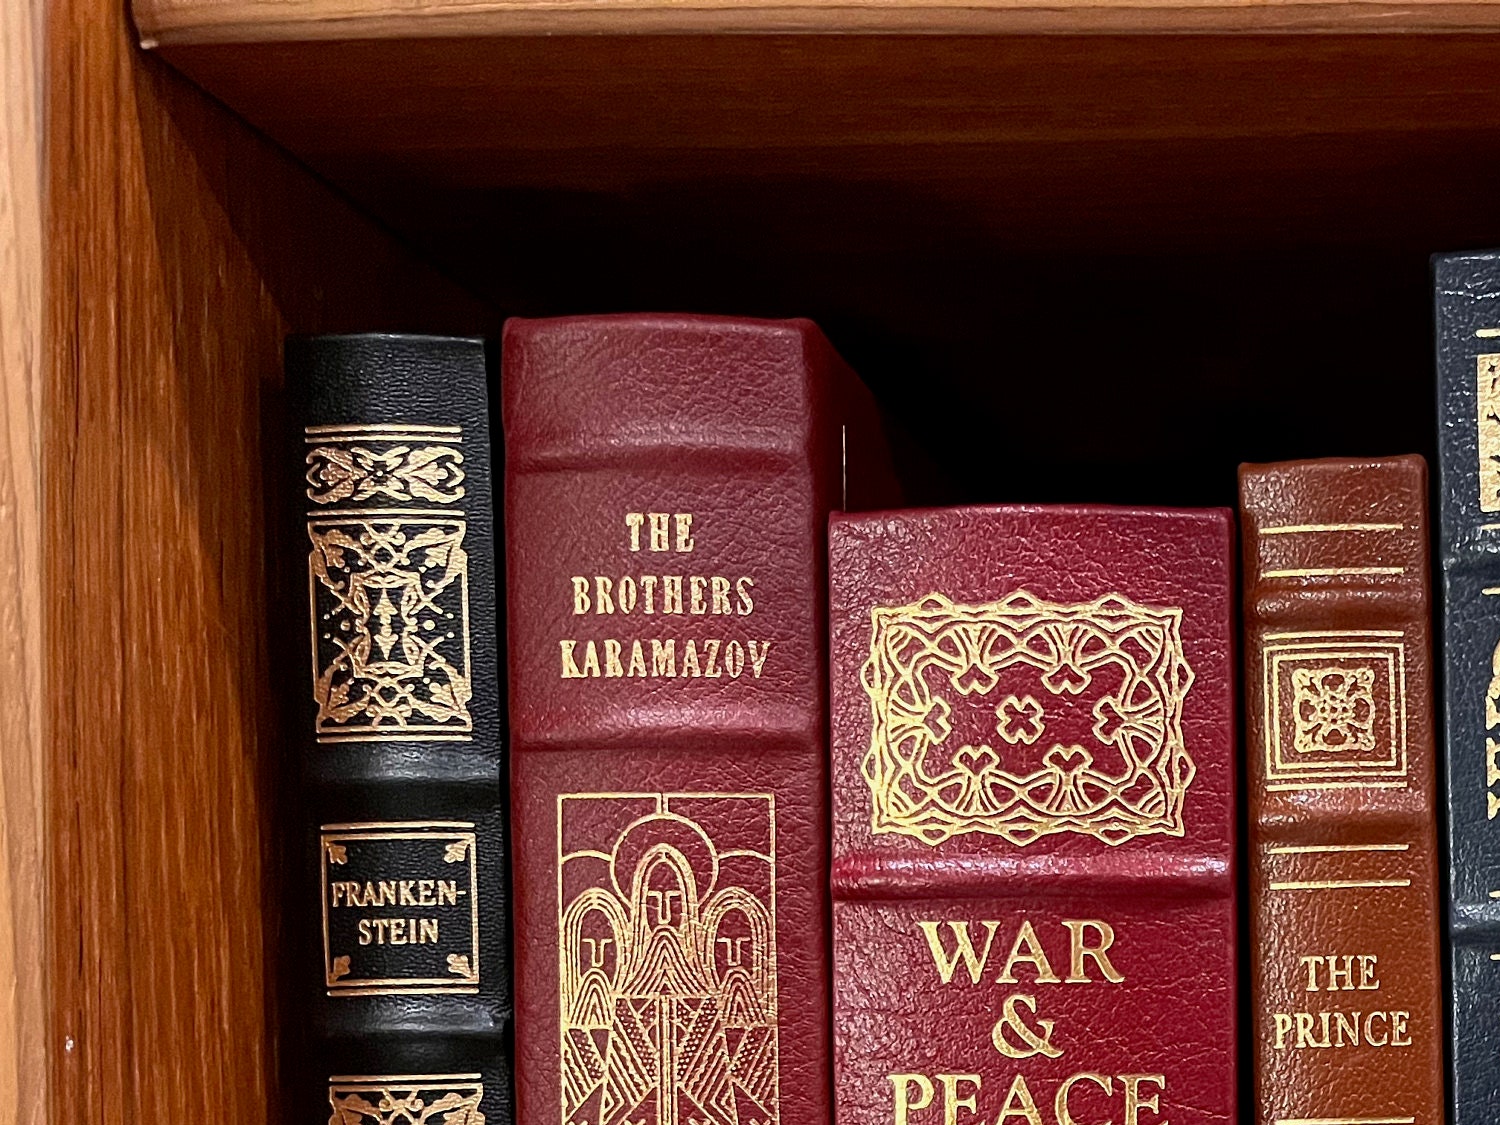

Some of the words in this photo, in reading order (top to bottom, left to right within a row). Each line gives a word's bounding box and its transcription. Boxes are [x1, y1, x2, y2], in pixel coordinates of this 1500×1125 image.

[625, 512, 694, 553] THE
[570, 575, 754, 616] BROTHERS
[559, 638, 771, 679] KARAMAZOV
[331, 879, 467, 908] FRANKEN-
[358, 918, 439, 946] STEIN
[916, 919, 1126, 985] WAR
[1298, 954, 1380, 992] THE
[991, 993, 1065, 1059] &
[1273, 1010, 1412, 1050] PRINCE
